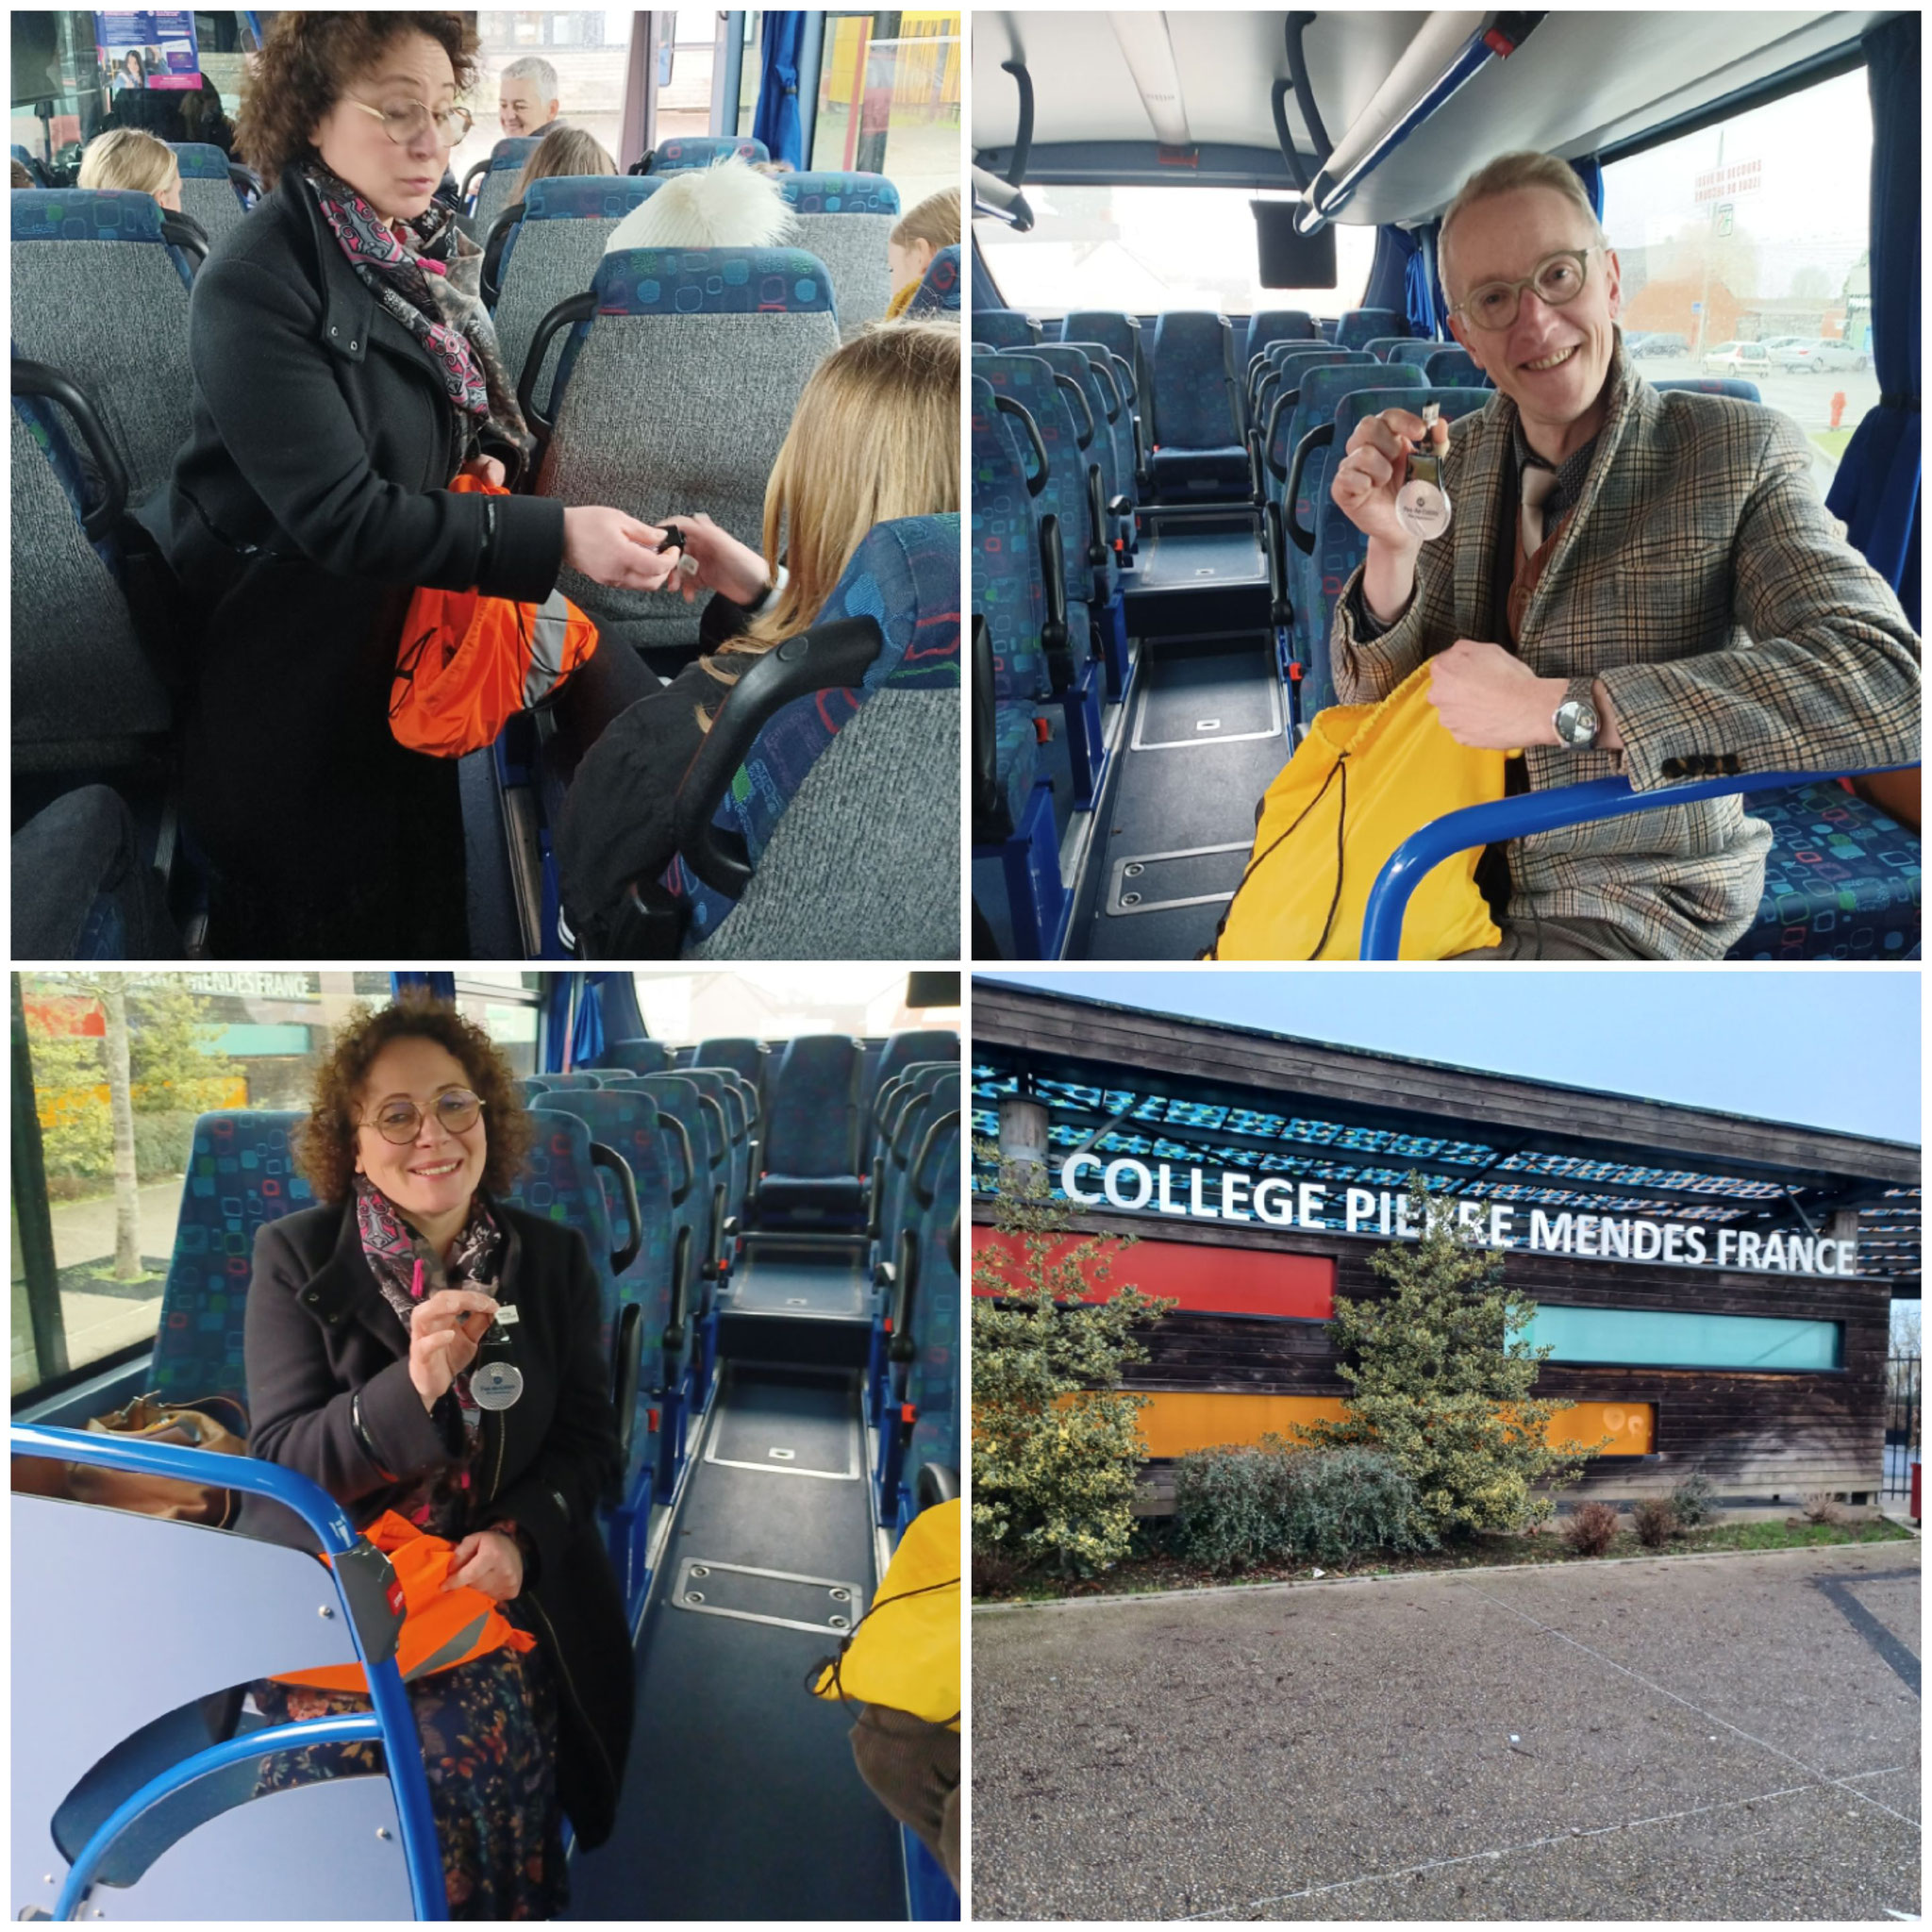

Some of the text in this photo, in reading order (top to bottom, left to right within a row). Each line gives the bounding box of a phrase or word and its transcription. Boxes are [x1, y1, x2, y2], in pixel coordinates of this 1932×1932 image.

[258, 972, 309, 998] FRANCE
[1061, 1153, 1326, 1229] COLLEGE
[1530, 1209, 1707, 1265] MENDES
[1717, 1228, 1856, 1275] FRANCE
